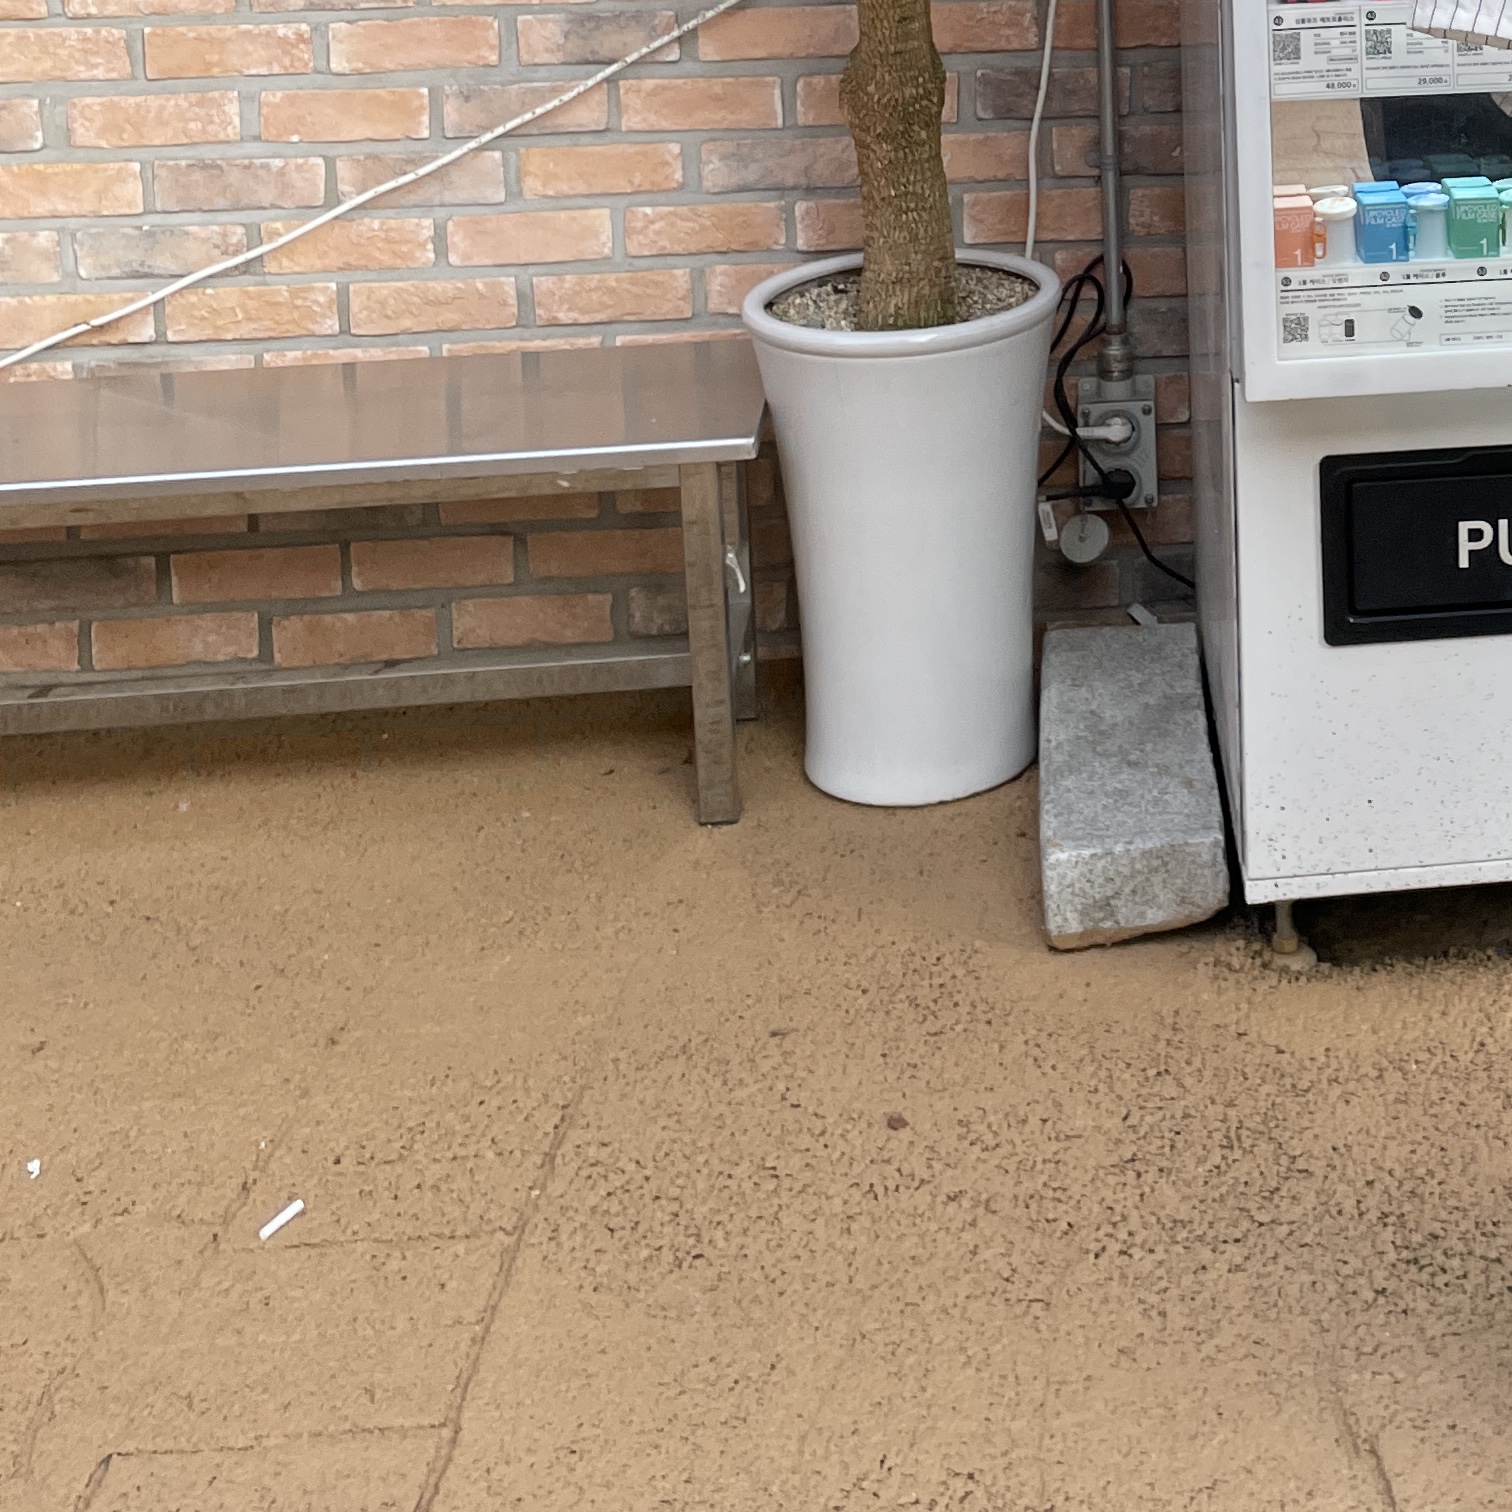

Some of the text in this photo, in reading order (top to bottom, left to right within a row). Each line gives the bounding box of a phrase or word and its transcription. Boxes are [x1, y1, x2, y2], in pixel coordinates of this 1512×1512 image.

[1365, 215, 1405, 225] FILM CASE
[1456, 211, 1497, 221] FILM CASE
[1389, 242, 1397, 260] 1
[1479, 237, 1488, 256] 1
[1293, 248, 1302, 266] 1
